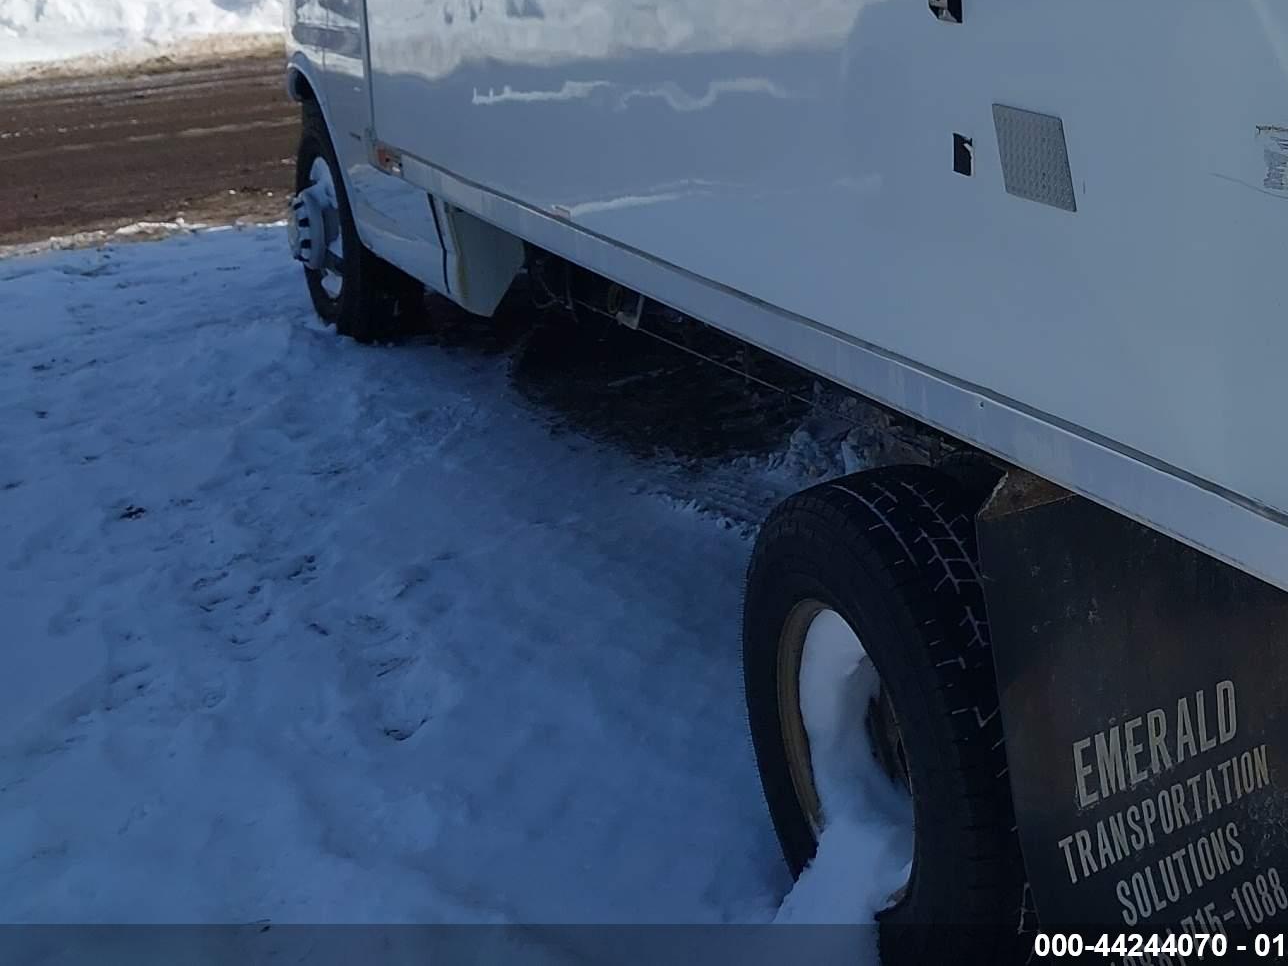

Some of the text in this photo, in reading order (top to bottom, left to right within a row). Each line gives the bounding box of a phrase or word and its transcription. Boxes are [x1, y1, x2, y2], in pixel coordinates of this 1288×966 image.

[1072, 680, 1238, 808] EMERALD
[1058, 745, 1271, 884] TRANSPORTATION
[1116, 822, 1245, 927] SOLUTIONS
